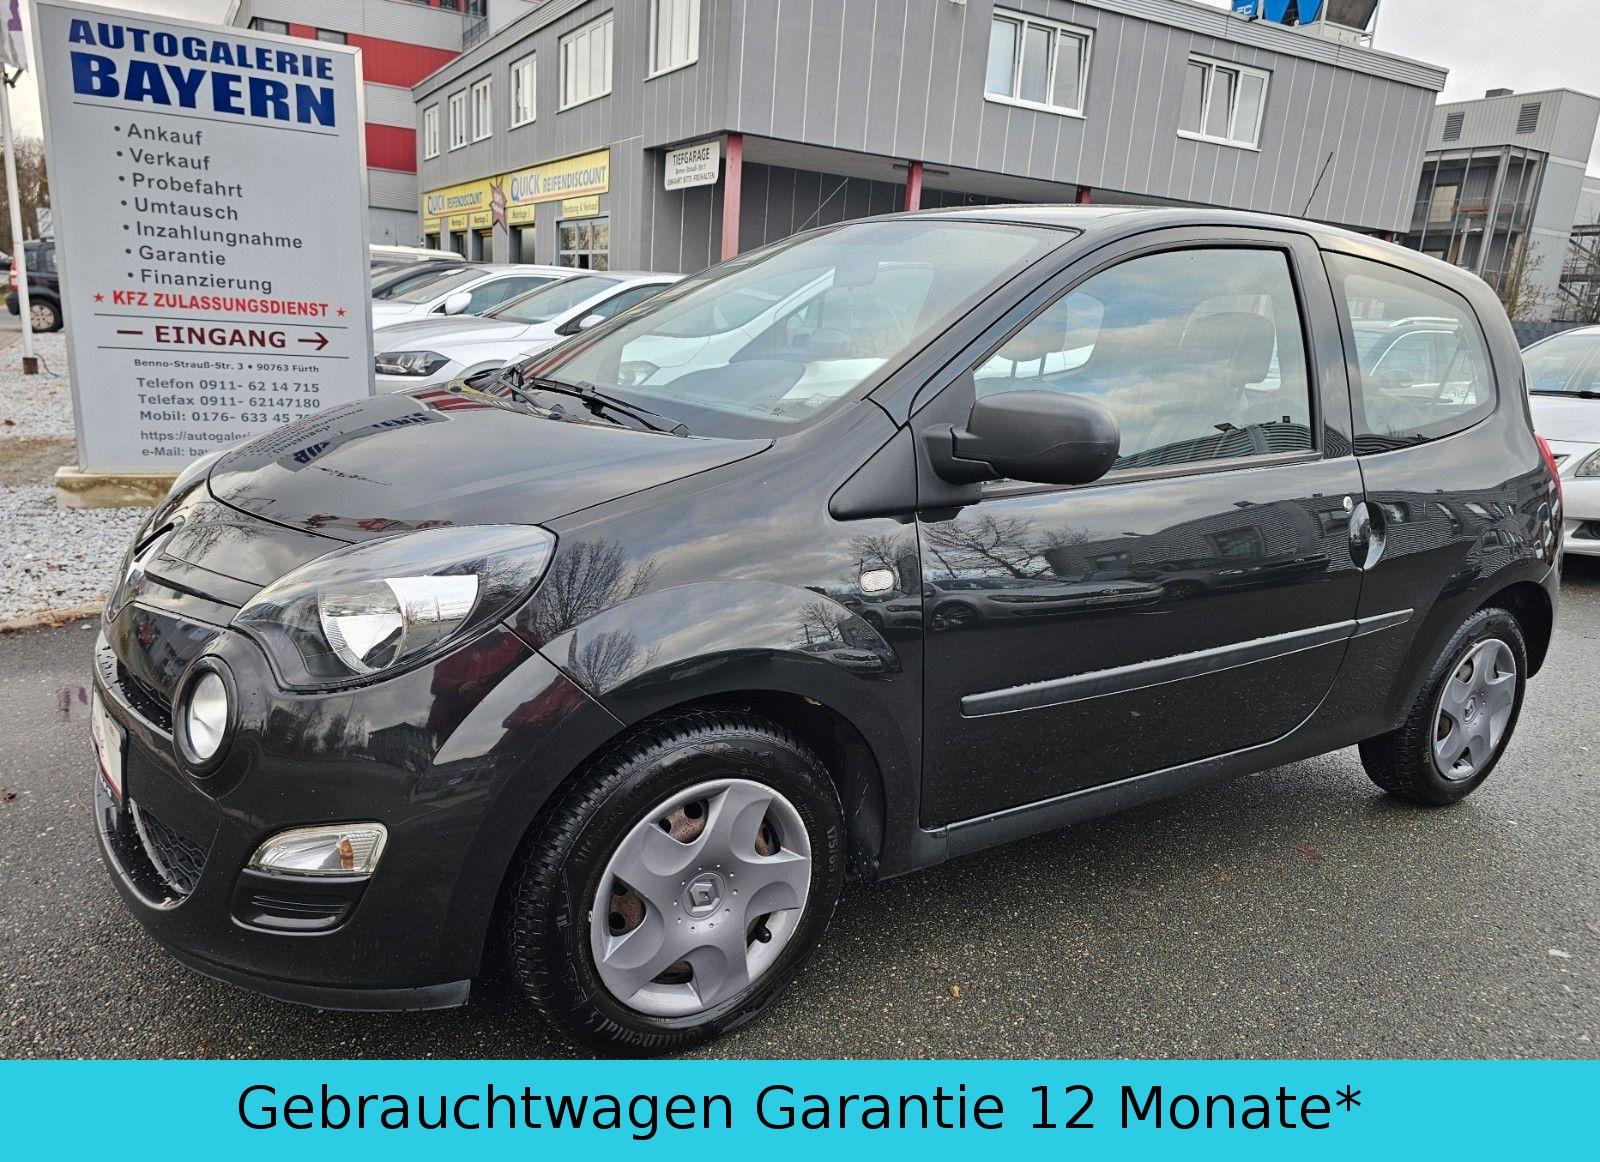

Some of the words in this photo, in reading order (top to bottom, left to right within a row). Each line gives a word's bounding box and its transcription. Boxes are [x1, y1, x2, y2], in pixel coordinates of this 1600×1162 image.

[68, 18, 335, 81] AUTOGALERIE
[70, 51, 337, 128] BAYERN
[127, 123, 203, 146] Ankauf
[130, 148, 211, 171] Verkauf
[673, 148, 710, 166] TIEFGARAGE
[132, 173, 243, 198] Probefahrt
[511, 173, 540, 201] QUICK
[543, 166, 606, 192] REIFENDISCOUNT
[134, 197, 239, 221] Umtausch
[136, 221, 303, 249] Inzahlungnahme
[140, 245, 226, 266] Garantie
[141, 269, 272, 294] Finanzierung
[112, 290, 148, 307] KFZ
[154, 292, 329, 317] ZULASSUNGSDIENST
[155, 325, 286, 349] EINGANG
[134, 358, 234, 371] Benno-Strauß-Str.
[257, 363, 289, 372] 90763
[292, 364, 320, 373] Fürth
[136, 377, 194, 390] Telefon
[199, 379, 243, 391] 0911-
[248, 382, 265, 392] 62
[272, 382, 289, 392] 14
[294, 383, 320, 393] 715
[138, 394, 195, 406] Telefax
[200, 395, 243, 407] 0911-
[249, 398, 320, 409] 62147180
[140, 410, 187, 422] Mobil:
[192, 411, 235, 423] 0176-
[241, 412, 267, 423] 633
[273, 413, 290, 423] 45
[142, 446, 185, 457] e-Mail:
